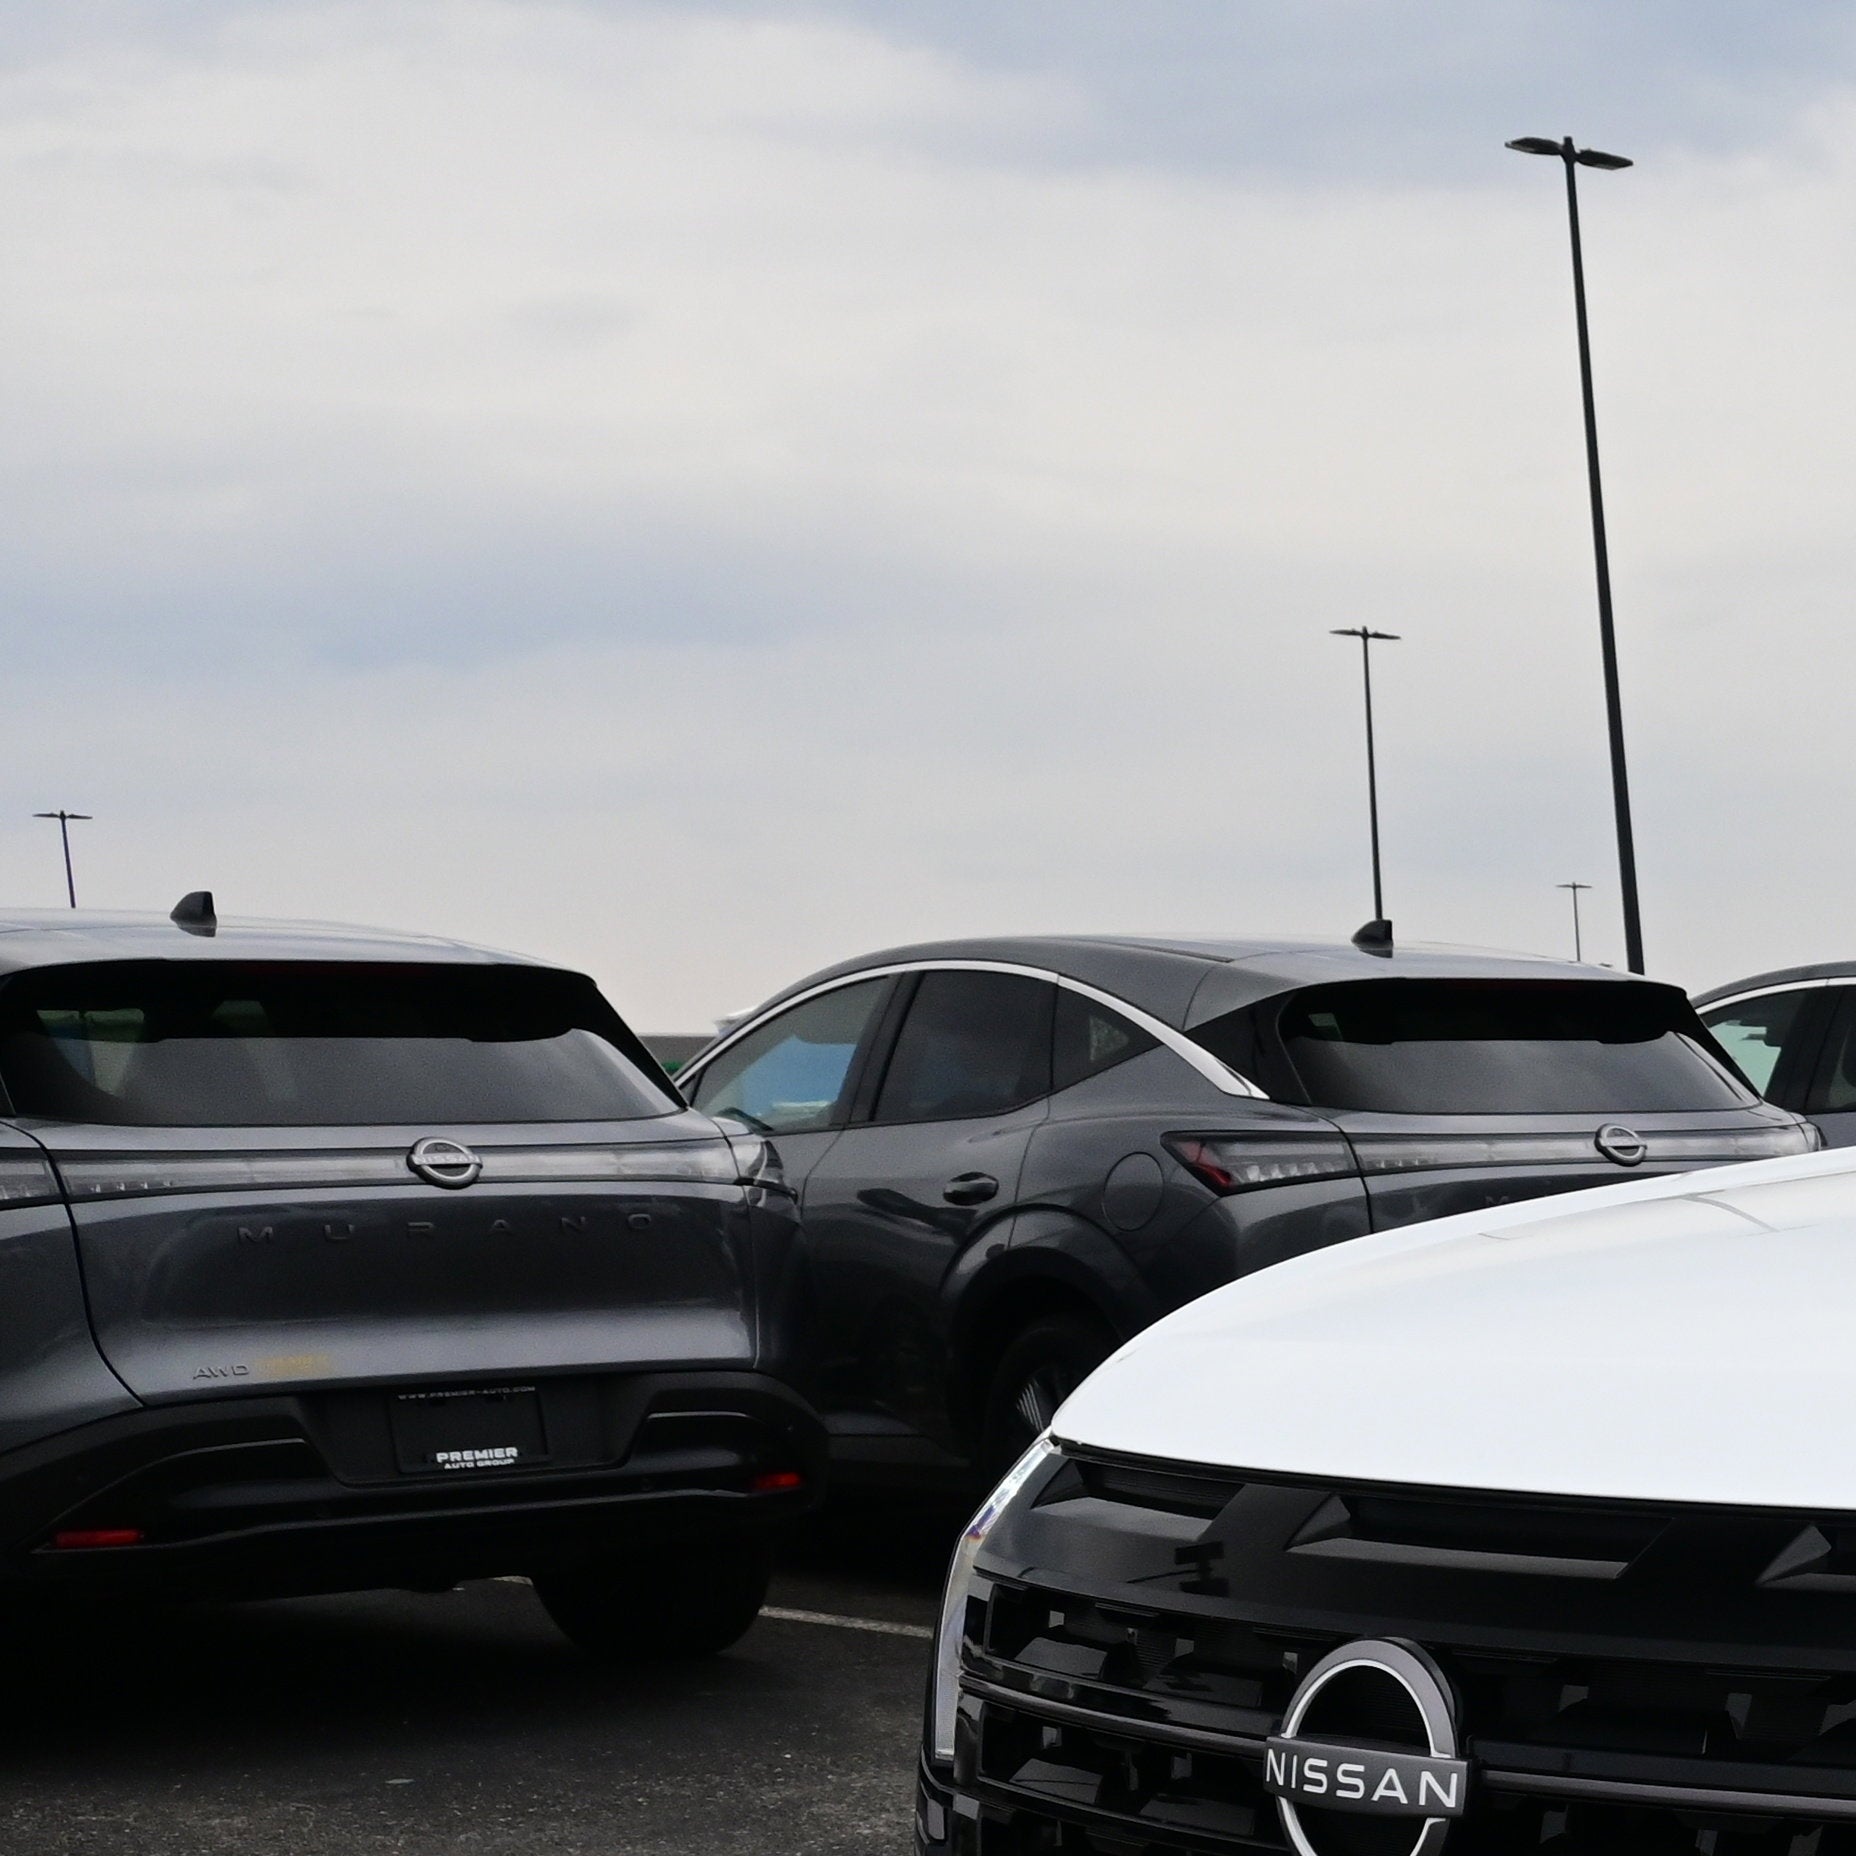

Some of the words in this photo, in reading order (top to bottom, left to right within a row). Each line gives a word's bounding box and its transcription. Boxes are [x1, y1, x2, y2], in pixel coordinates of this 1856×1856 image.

[237, 1212, 653, 1245] MURANO
[193, 1363, 250, 1381] AWD
[435, 1447, 519, 1464] PREMIER
[444, 1460, 475, 1470] AUTO
[476, 1458, 516, 1468] GROUP
[1265, 1747, 1460, 1809] NISSAN
